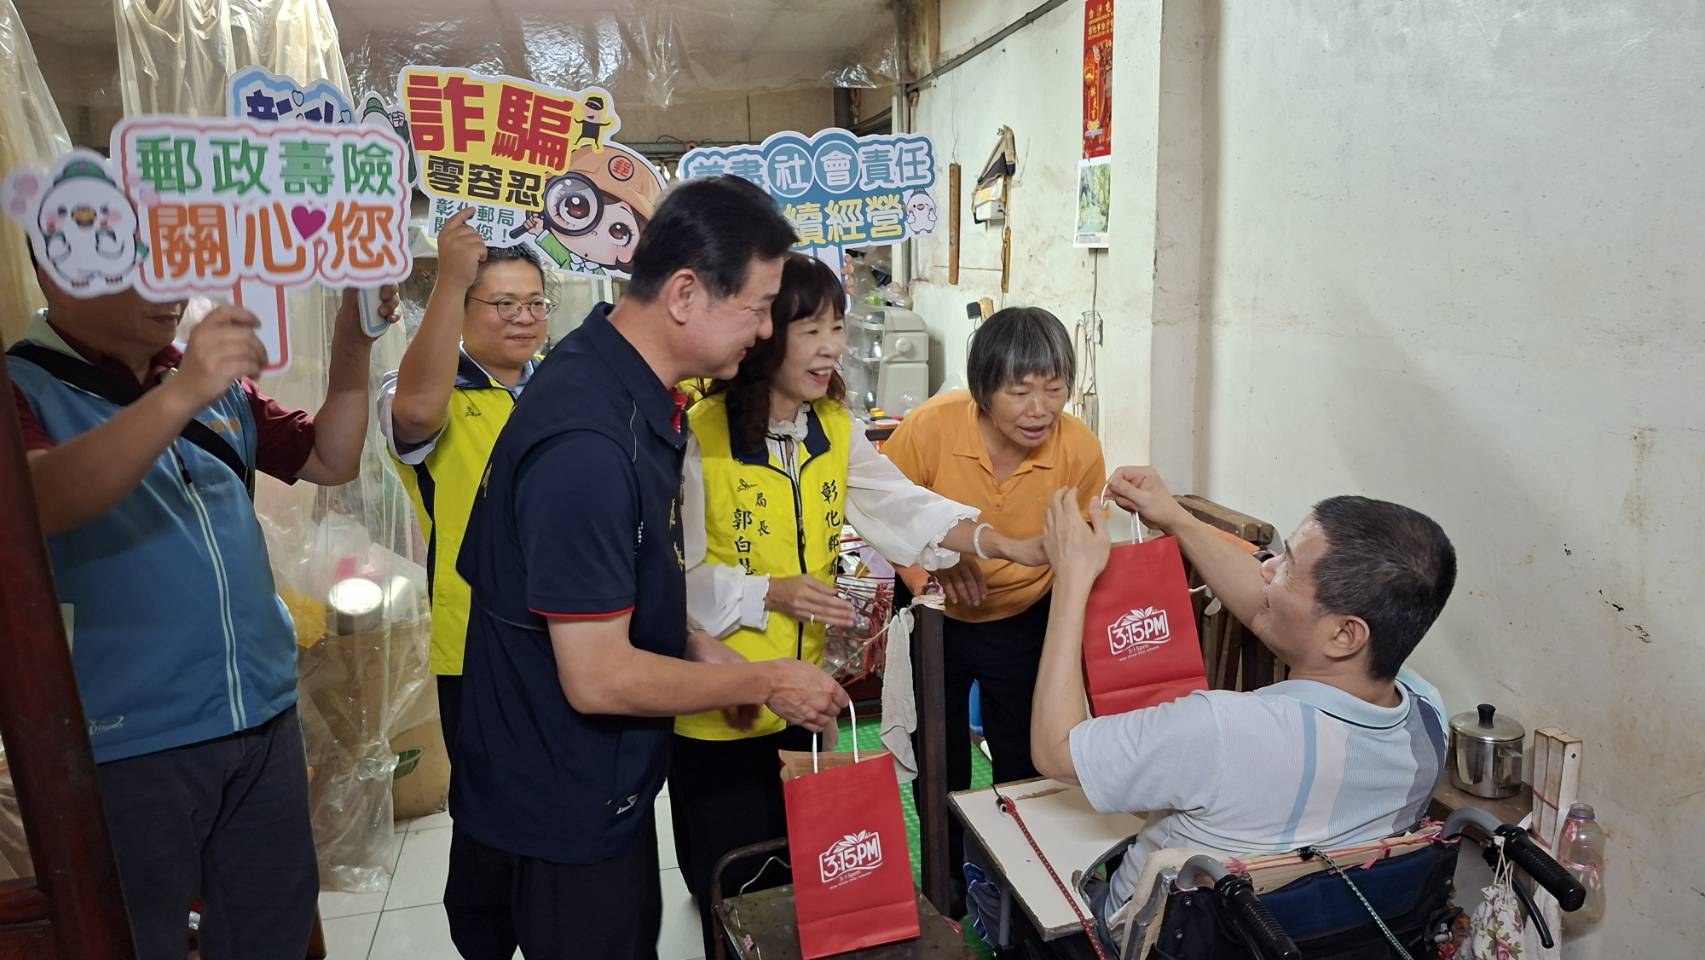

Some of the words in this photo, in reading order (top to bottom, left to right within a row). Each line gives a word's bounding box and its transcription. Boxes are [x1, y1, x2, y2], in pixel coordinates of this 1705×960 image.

[407, 74, 575, 171] 詐騙
[136, 133, 396, 196] 郵政壽險
[427, 154, 543, 208] 零容忍
[147, 201, 398, 281] 關心您
[755, 491, 771, 536] 局長
[1112, 615, 1165, 649] 3:15PM
[823, 838, 878, 877] 3:15PM
